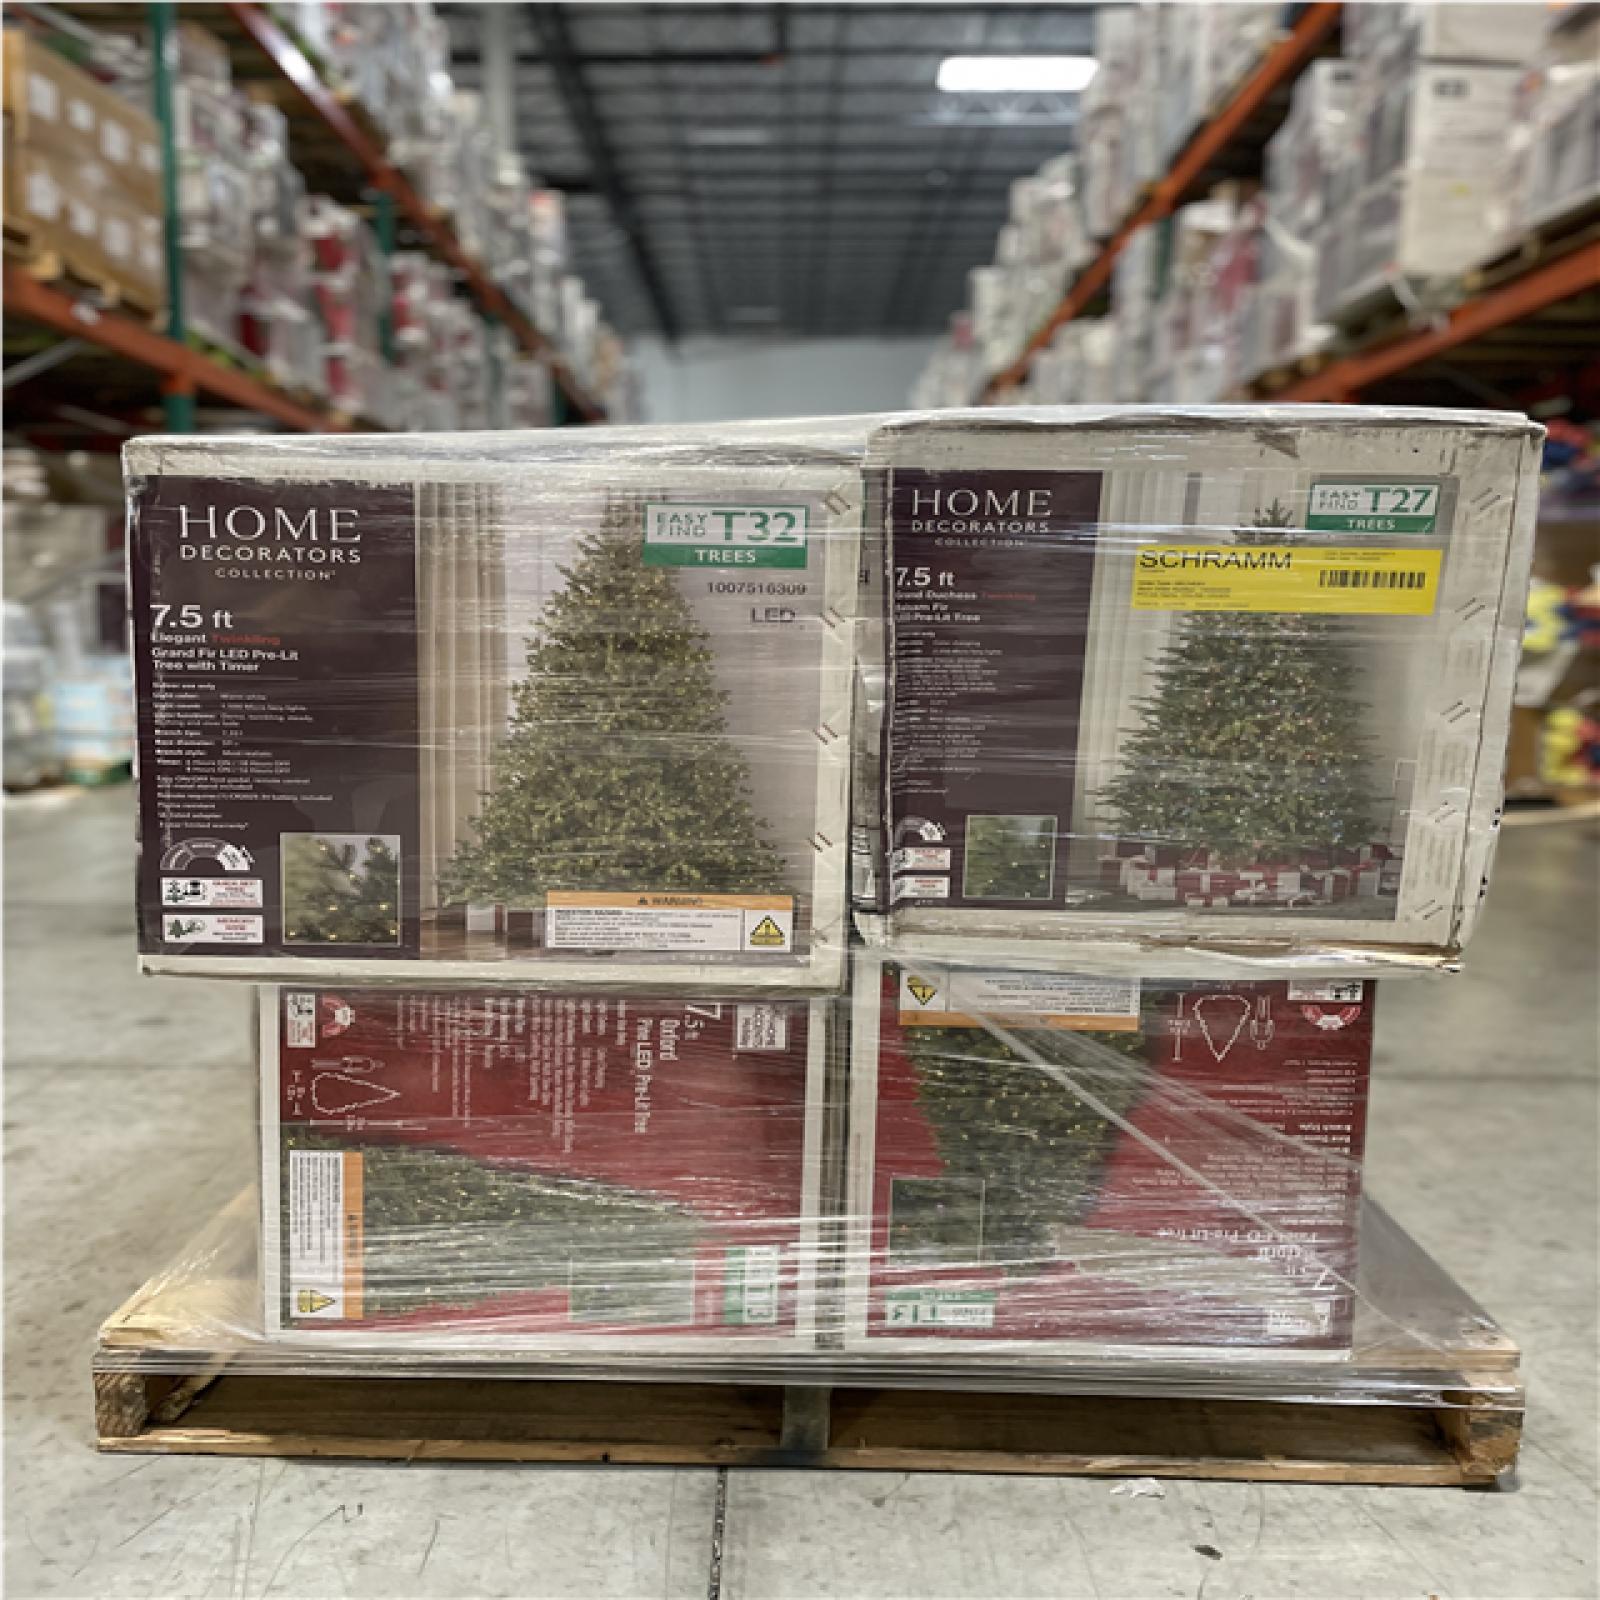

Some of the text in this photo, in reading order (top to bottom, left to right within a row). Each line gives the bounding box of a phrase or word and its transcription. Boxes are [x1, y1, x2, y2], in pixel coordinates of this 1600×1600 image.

[911, 488, 1053, 517] HOME
[1319, 487, 1433, 513] EASY T27
[1319, 498, 1359, 510] FIND
[178, 504, 362, 543] HOME
[656, 509, 799, 543] EASY T32
[656, 523, 707, 537] FIND
[911, 519, 1050, 534] DECORATORS
[1348, 519, 1396, 531] TREES
[179, 543, 362, 564] DECORATORS
[695, 549, 756, 564] TREES
[1138, 549, 1292, 570] SCHRAMM
[214, 567, 332, 581] COLLECTION
[895, 566, 955, 587] 7.5 ft
[150, 604, 233, 629] 7.5 ft
[751, 606, 796, 623] LED
[152, 647, 196, 659] Grand
[218, 648, 250, 660] LED
[251, 648, 299, 662] Pre-Lit
[153, 659, 184, 672] Tree
[636, 1041, 652, 1070] LED
